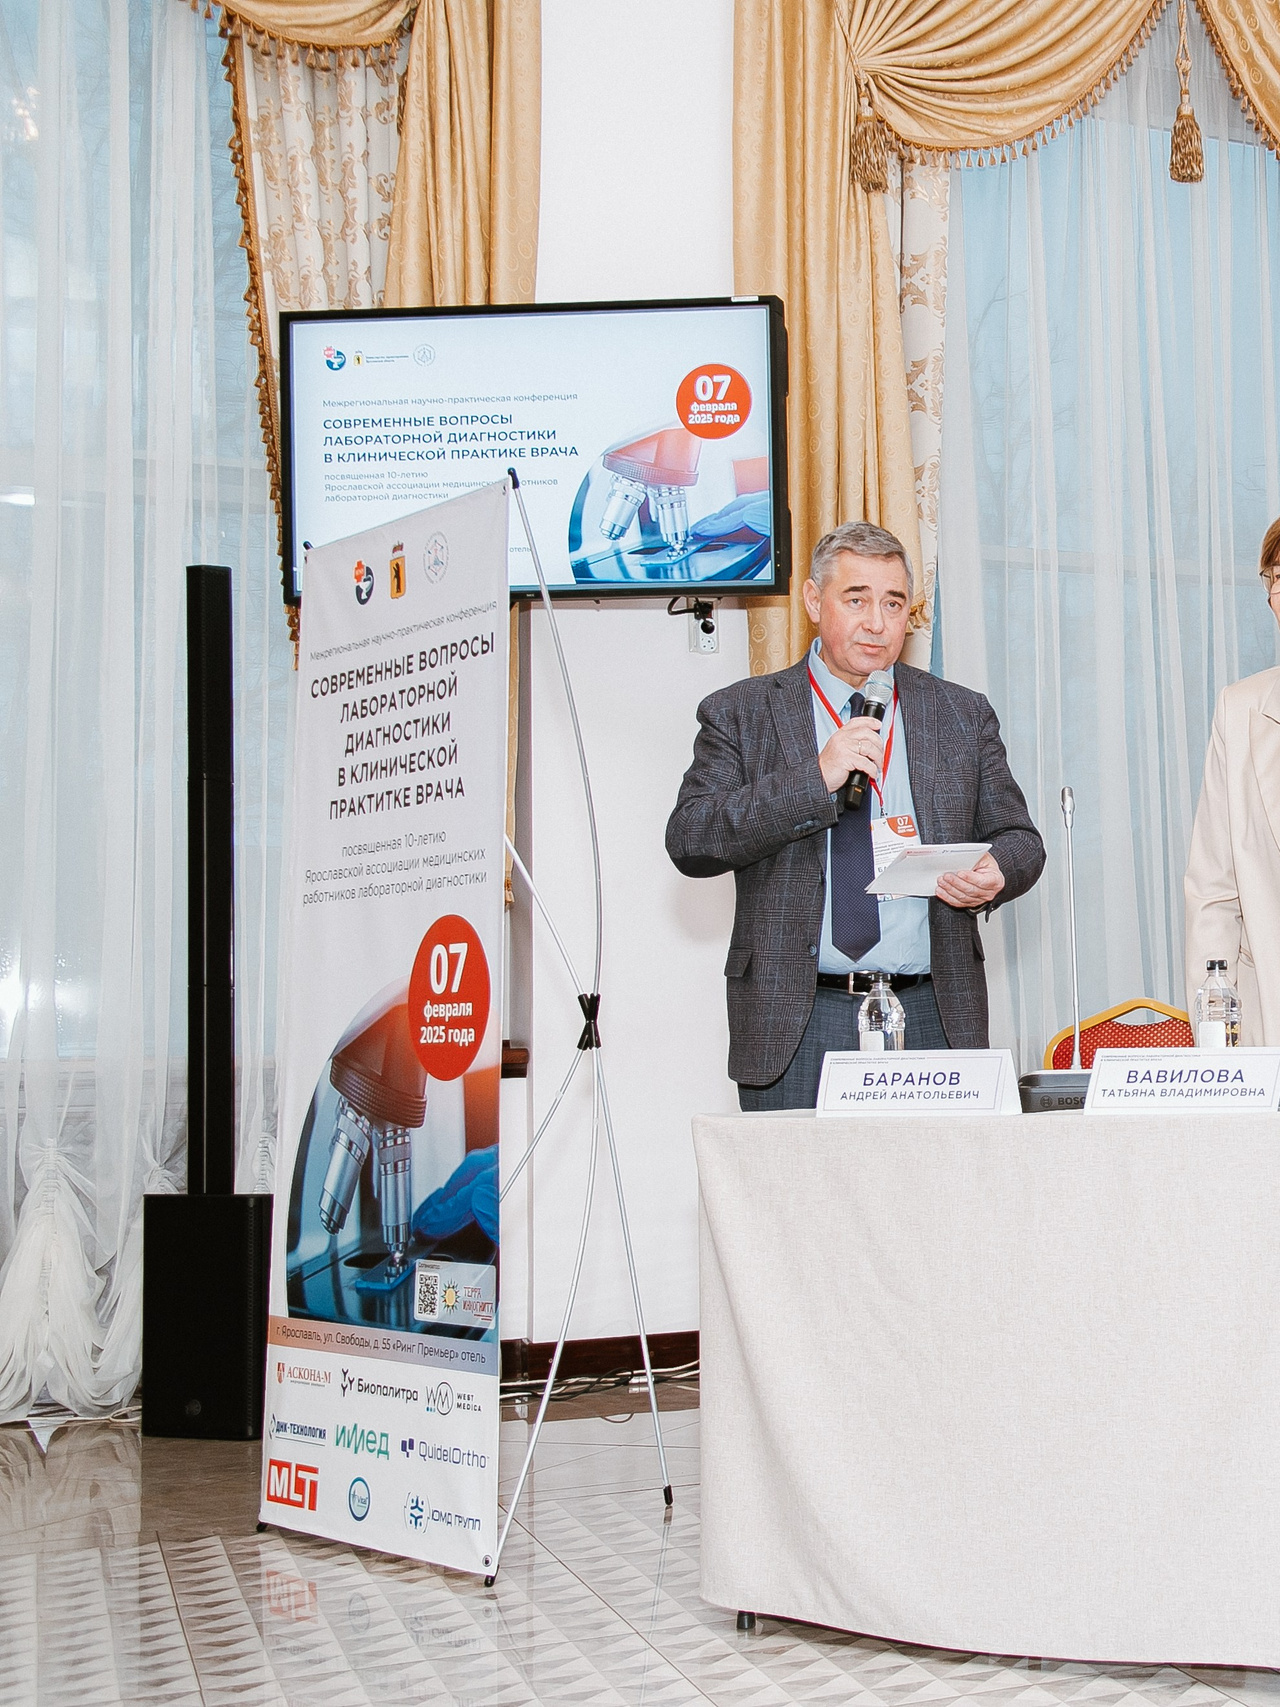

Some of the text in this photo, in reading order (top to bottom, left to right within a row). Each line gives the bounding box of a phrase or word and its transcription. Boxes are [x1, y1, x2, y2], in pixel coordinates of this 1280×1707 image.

[694, 375, 732, 402] 07
[323, 393, 578, 408] Межрегиональная научно-практическая конференция
[690, 401, 738, 414] февраля
[323, 414, 513, 430] СОВРЕМЕННЫЕ ВОПРОСЫ
[688, 413, 740, 425] 2025 года
[323, 430, 556, 447] ЛАБОРАТОРНОЙ ДИАГНОСТИКИ
[324, 446, 579, 463] В КЛИНИЧЕСКОЙ ПРАКТИКЕ ВРАЧА
[324, 471, 428, 481] посвященная 10-летию
[324, 482, 384, 492] Ярославской
[386, 481, 440, 490] ассоциации
[443, 480, 501, 489] медицинск
[325, 492, 449, 503] лабораторной диагностики
[311, 632, 494, 698] СОВРЕМЕННЫЕ ВОПРОСЫ
[340, 670, 458, 723] ЛАБОРАТОРНОЙ
[345, 711, 451, 757] ДИАГНОСТИКИ
[338, 738, 458, 787] В КЛИНИЧЕСКОЙ
[329, 776, 465, 820] ПРАКТИТКЕ ВРАЧА
[896, 816, 909, 826] 07
[342, 830, 446, 857] посвященная 10-летию
[305, 848, 486, 884] Ярославской ассоциации медицинских
[303, 871, 487, 906] работников лабораторной диагностики
[430, 942, 468, 995] 07
[423, 1000, 473, 1022] февраля
[419, 1026, 475, 1047] 2025 года
[863, 1071, 961, 1087] БАРАНОВ
[1126, 1069, 1245, 1084] ВАВИЛОВА
[840, 1088, 980, 1101] АНДРЕЙ АНАТОЛЬЕВИЧ
[1058, 1096, 1087, 1106] BOSC
[1101, 1087, 1266, 1099] ТАТЬЯНА ВЛАДИМИРОВНА
[276, 1325, 486, 1364] г. Ярославль, ул. Свободы, д. 55 «Ринг Премьер» отель
[286, 1366, 332, 1384] АСКОНА-М
[357, 1378, 419, 1404] Биопалитра
[457, 1393, 475, 1402] WEST
[457, 1402, 482, 1412] MEDICA
[275, 1421, 327, 1440] ДНК-ТЕХНОЛОГИЯ
[268, 1460, 319, 1511] MLT
[454, 1514, 481, 1531] ГРУПП
